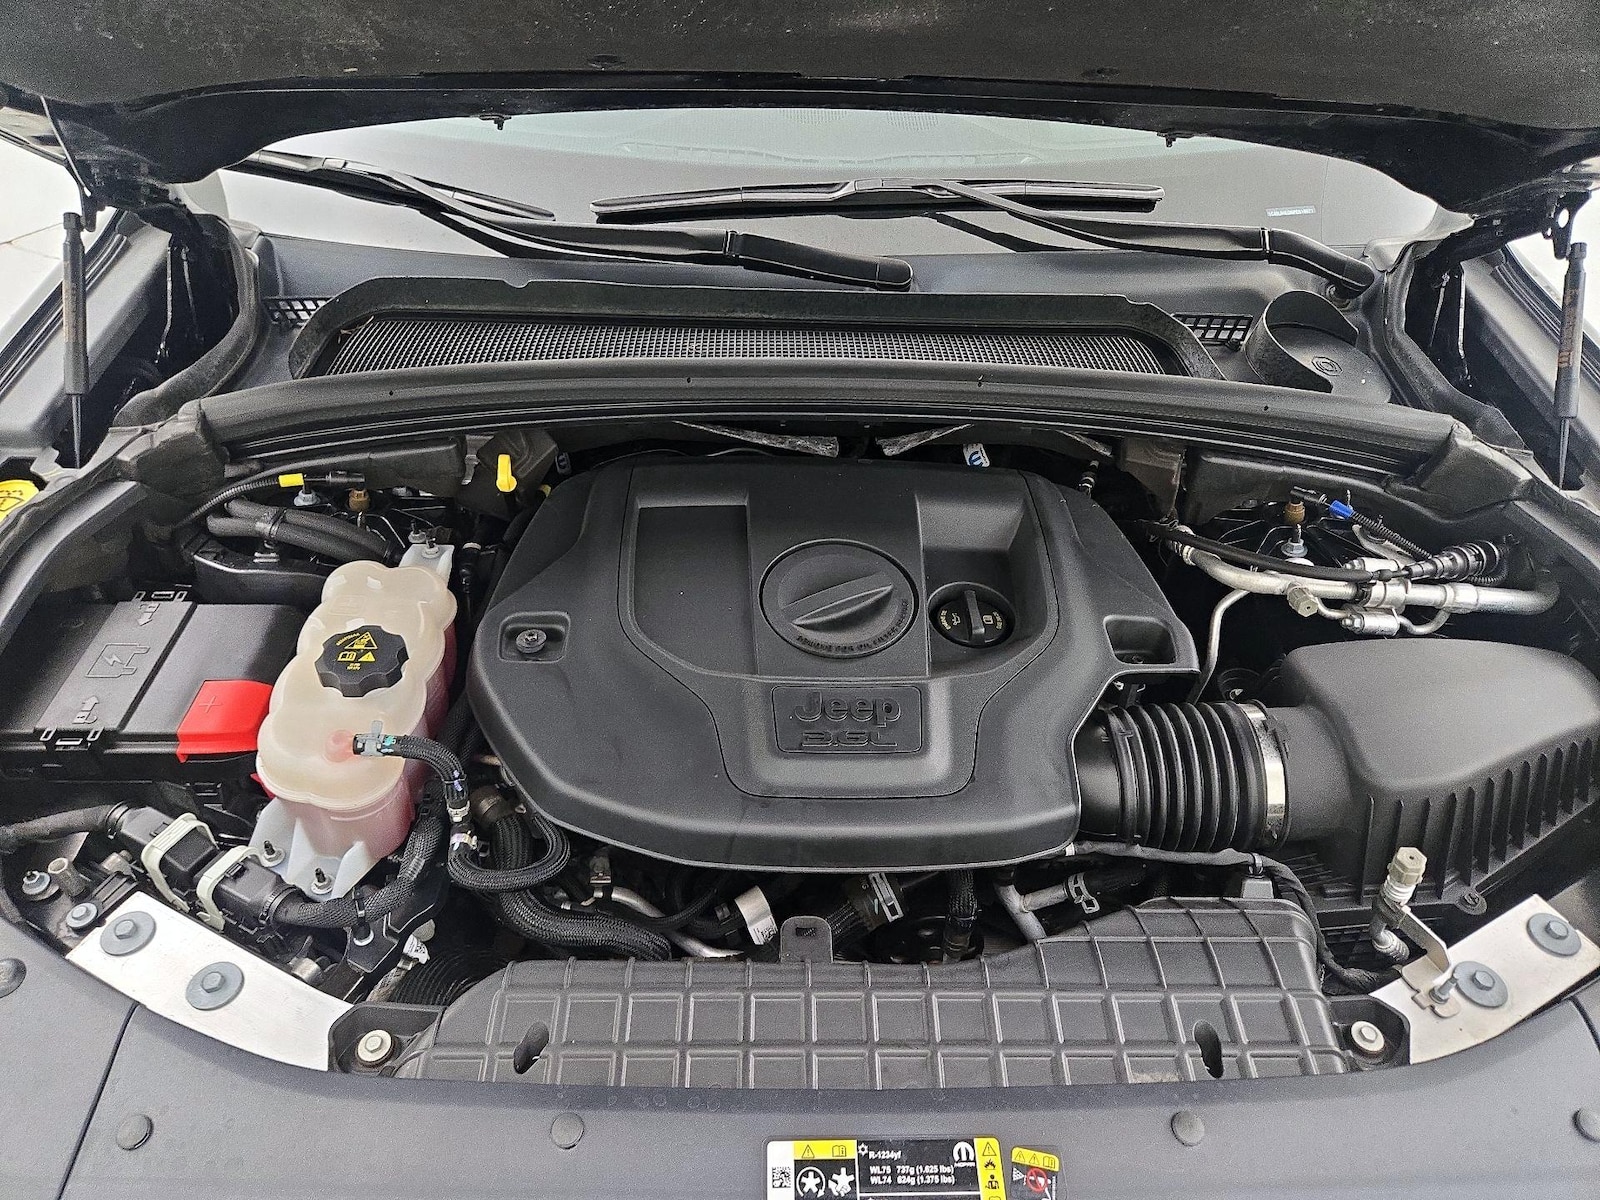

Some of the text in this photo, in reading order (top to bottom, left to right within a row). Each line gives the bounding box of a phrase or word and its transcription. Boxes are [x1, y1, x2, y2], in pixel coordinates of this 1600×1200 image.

[795, 691, 901, 728] Jeep
[869, 1164, 955, 1175] WL75 737g (1.625 lbs)
[870, 1174, 956, 1186] WL74 624g (1.375 lbs)
